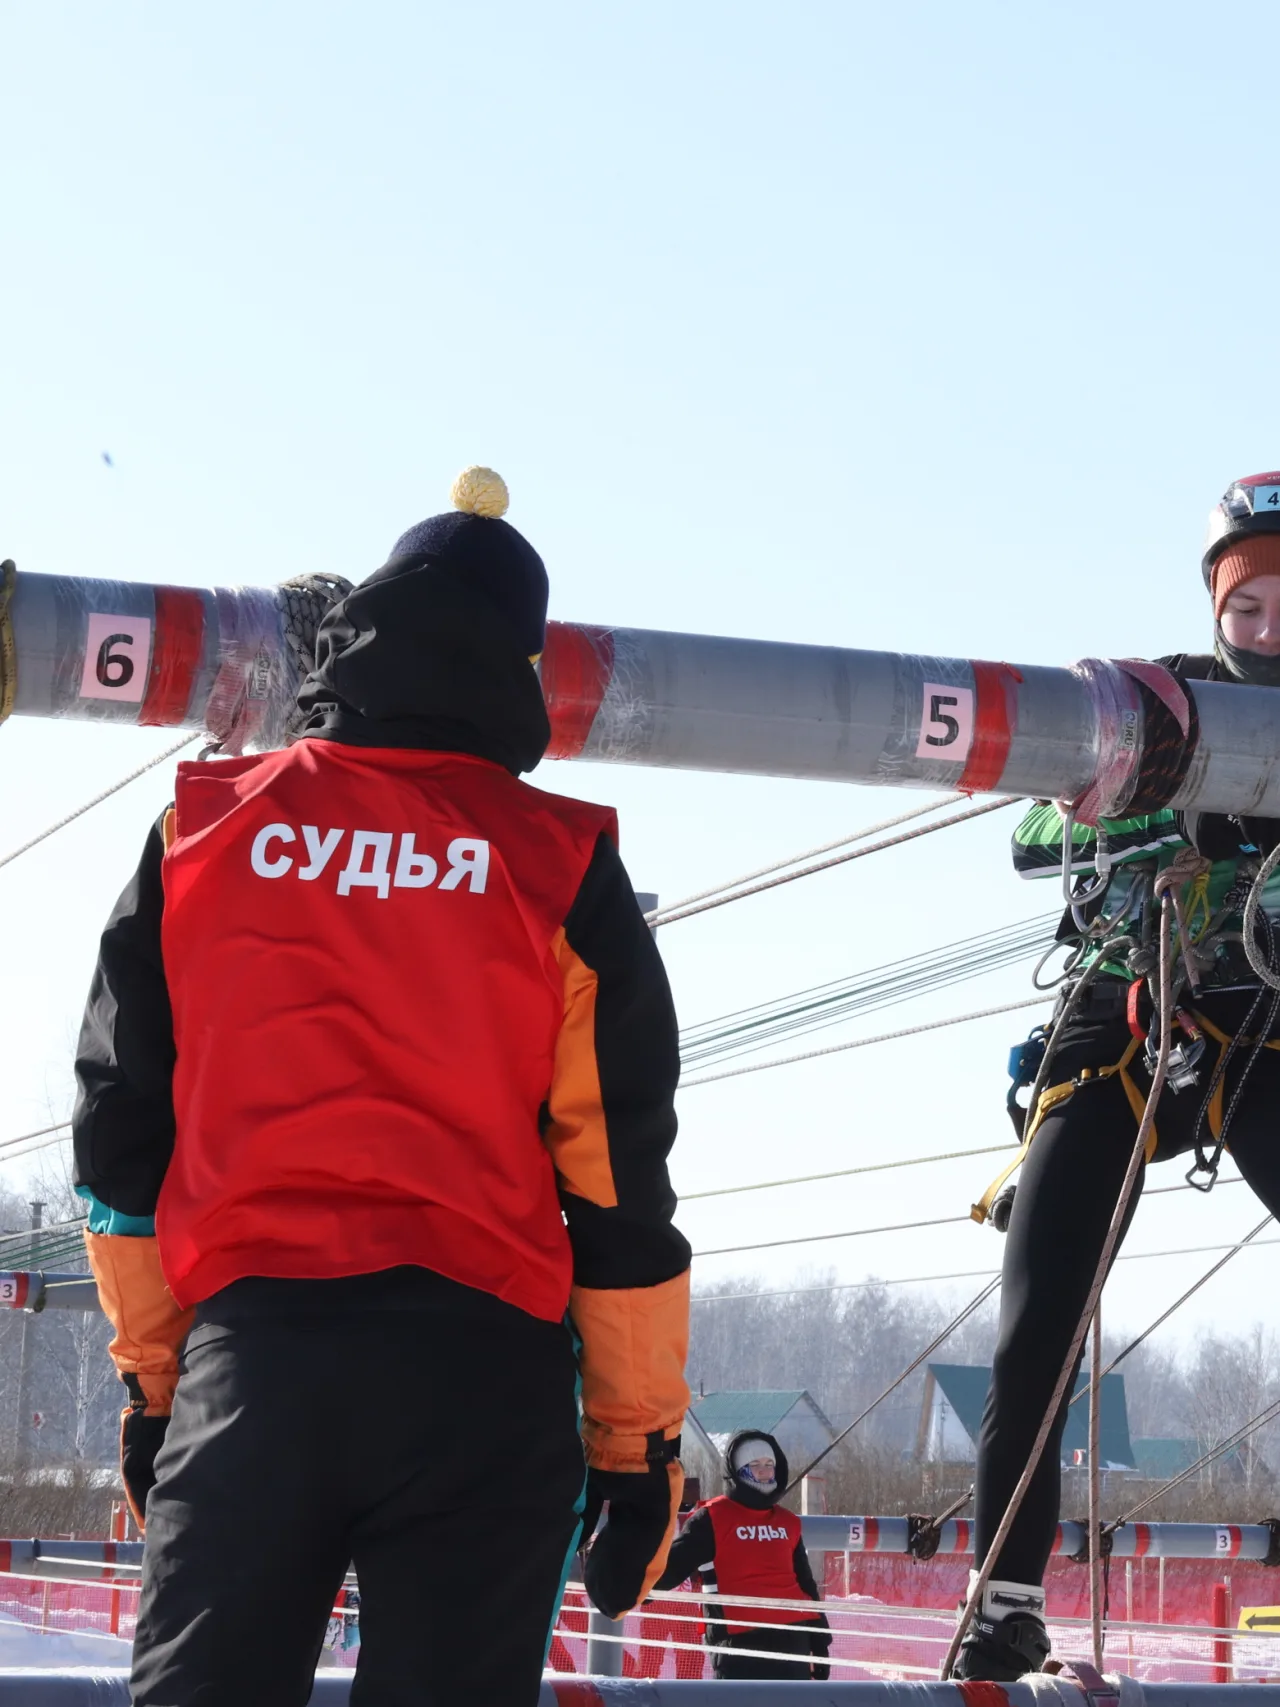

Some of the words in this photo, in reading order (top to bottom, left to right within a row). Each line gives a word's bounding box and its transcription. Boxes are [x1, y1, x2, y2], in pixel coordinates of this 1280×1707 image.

[96, 633, 134, 688] 6
[925, 695, 960, 747] 5
[250, 822, 491, 899] СУДЬЯ
[2, 1283, 13, 1298] 3
[736, 1524, 789, 1542] СУДЬЯ
[851, 1526, 860, 1541] 5
[1219, 1534, 1229, 1549] 3
